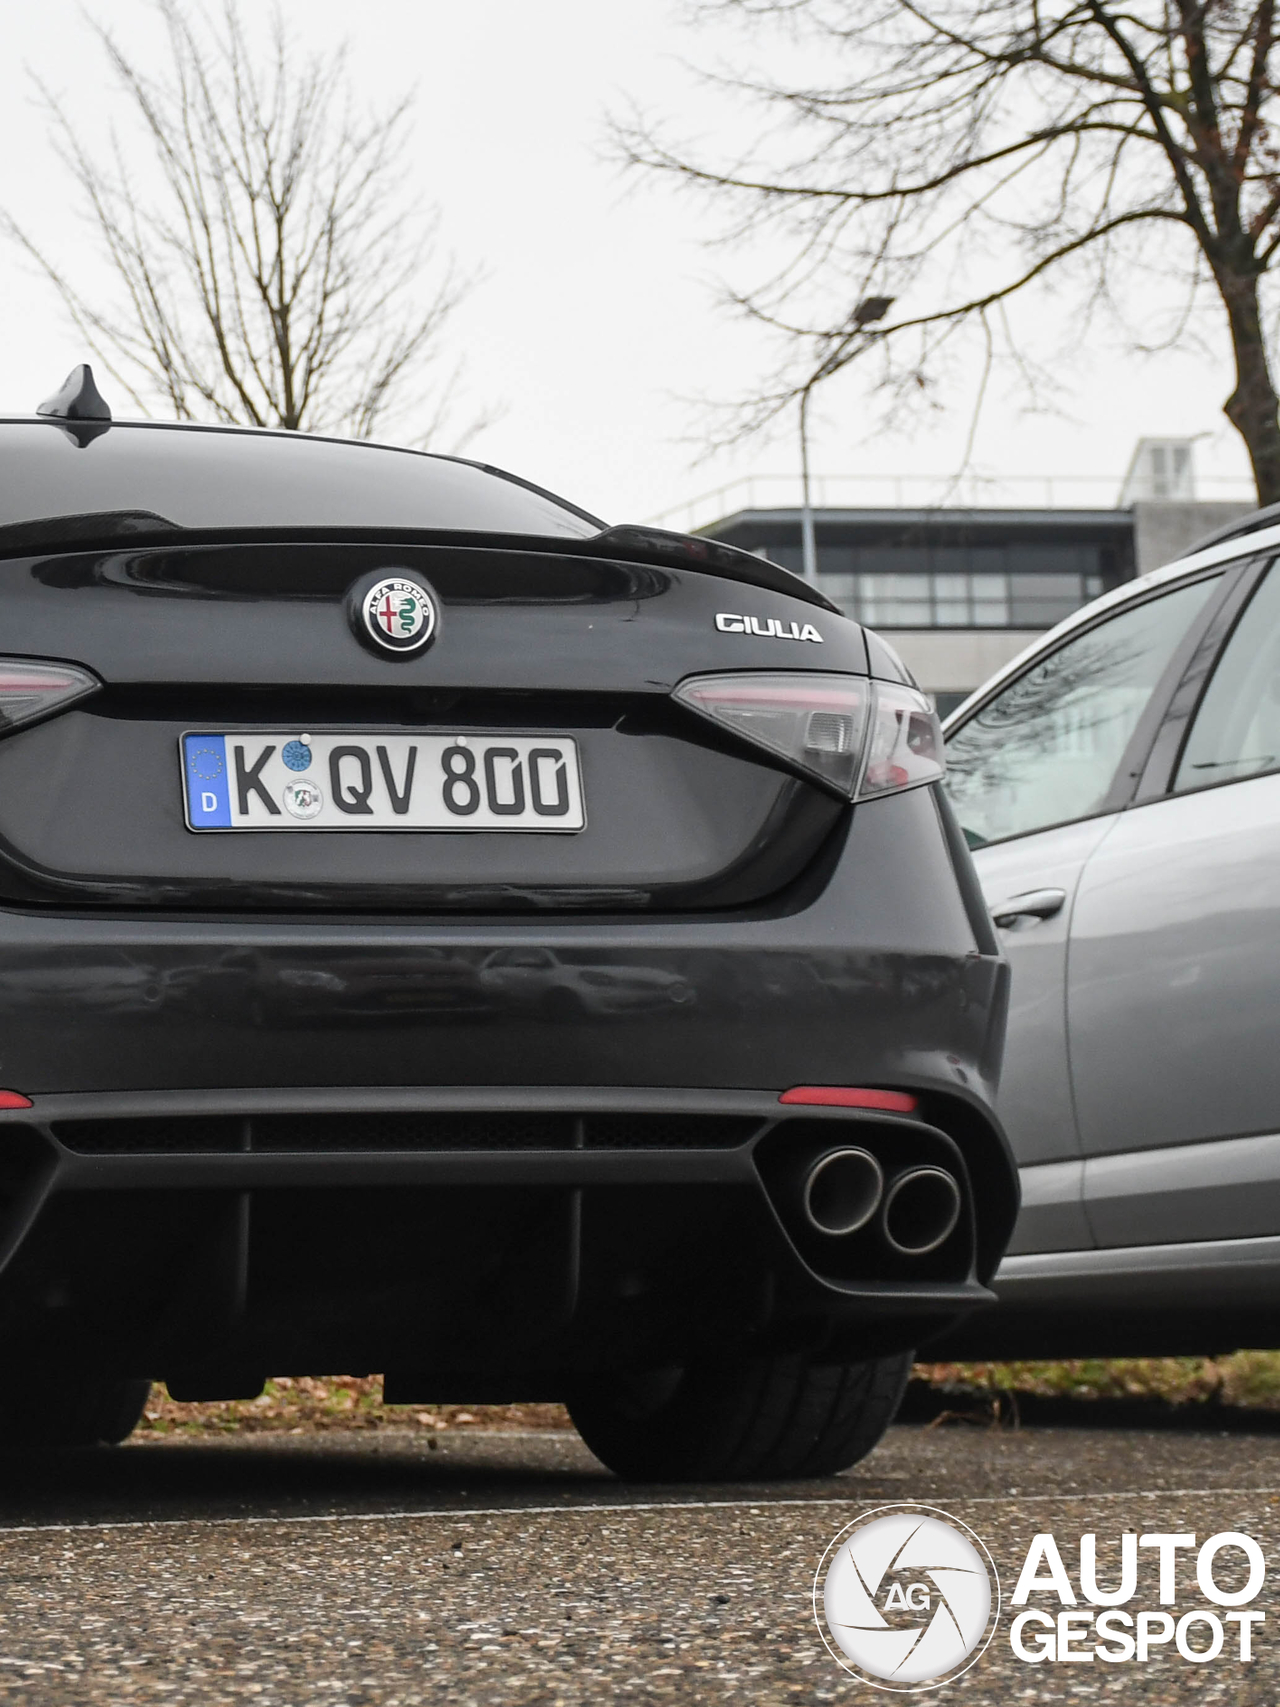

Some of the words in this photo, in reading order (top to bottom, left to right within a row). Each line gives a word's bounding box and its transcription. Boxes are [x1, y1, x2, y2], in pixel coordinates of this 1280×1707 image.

[370, 587, 390, 614] ALFA
[393, 583, 429, 616] ROMEO
[716, 613, 824, 642] GIULIA
[233, 745, 282, 815] K
[328, 745, 418, 815] QV
[441, 745, 571, 816] 800
[201, 791, 218, 812] D
